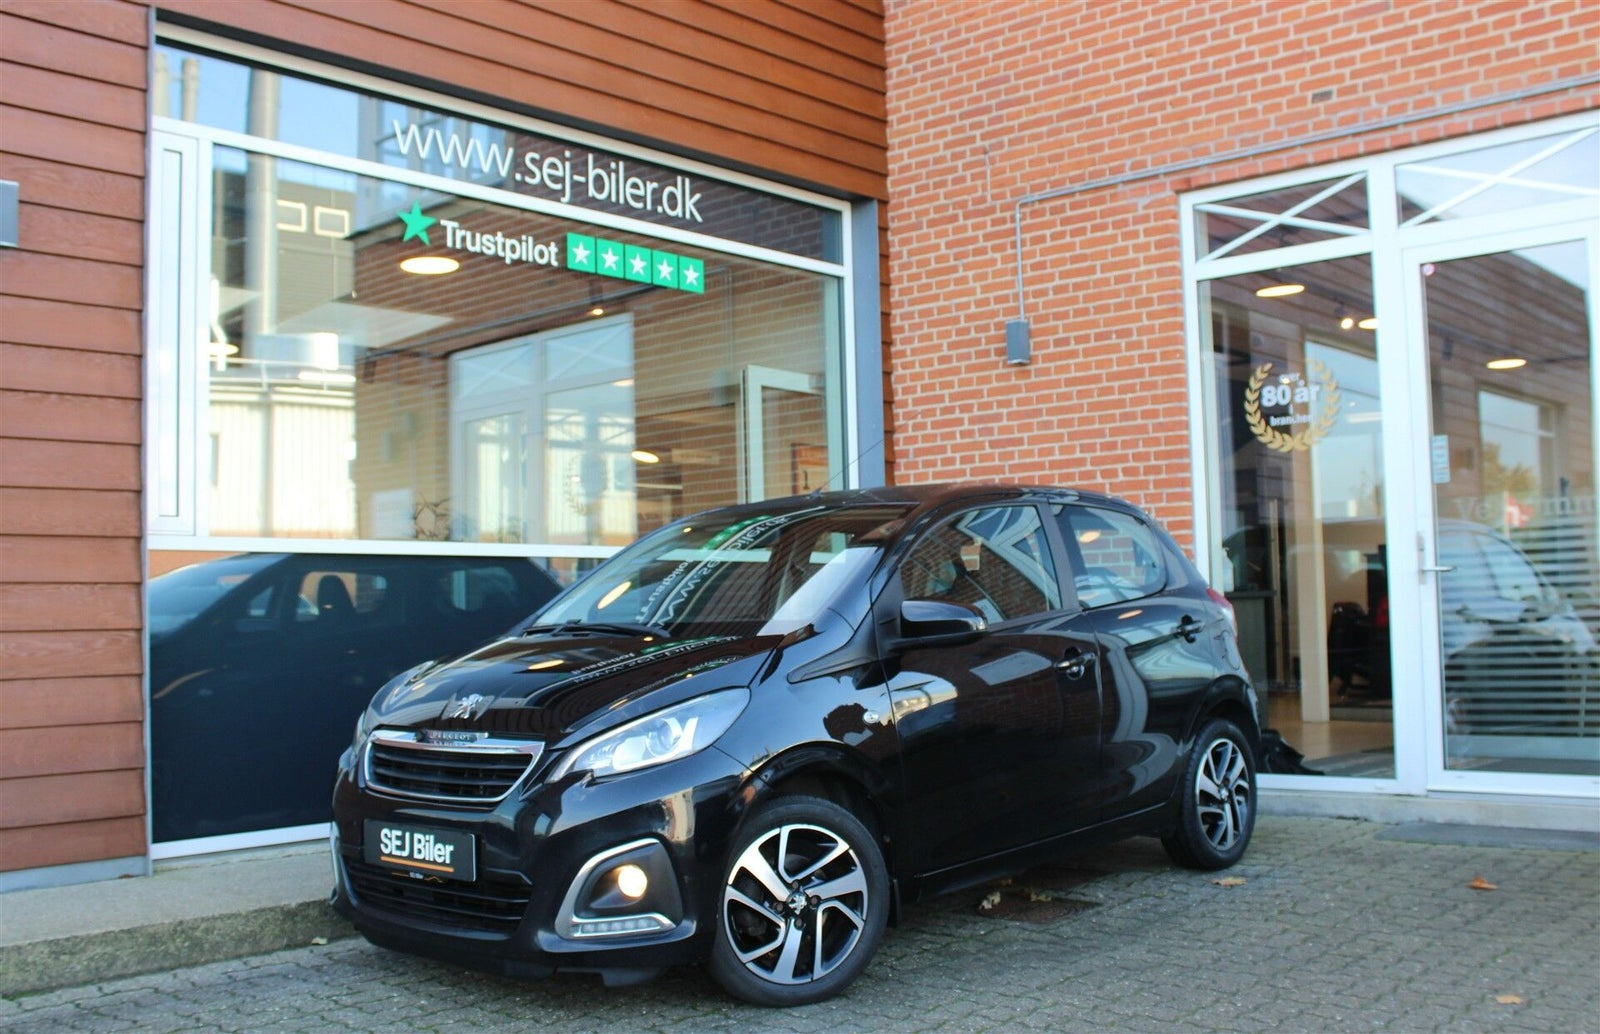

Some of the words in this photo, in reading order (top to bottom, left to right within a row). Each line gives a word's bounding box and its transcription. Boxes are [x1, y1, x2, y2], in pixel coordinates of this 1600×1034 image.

[392, 119, 703, 223] www.sej-biler.dk
[440, 219, 559, 267] Trustpilot
[1261, 384, 1292, 407] 80
[1294, 379, 1320, 404] år
[380, 827, 411, 857] SEJ
[413, 832, 454, 864] Biler
